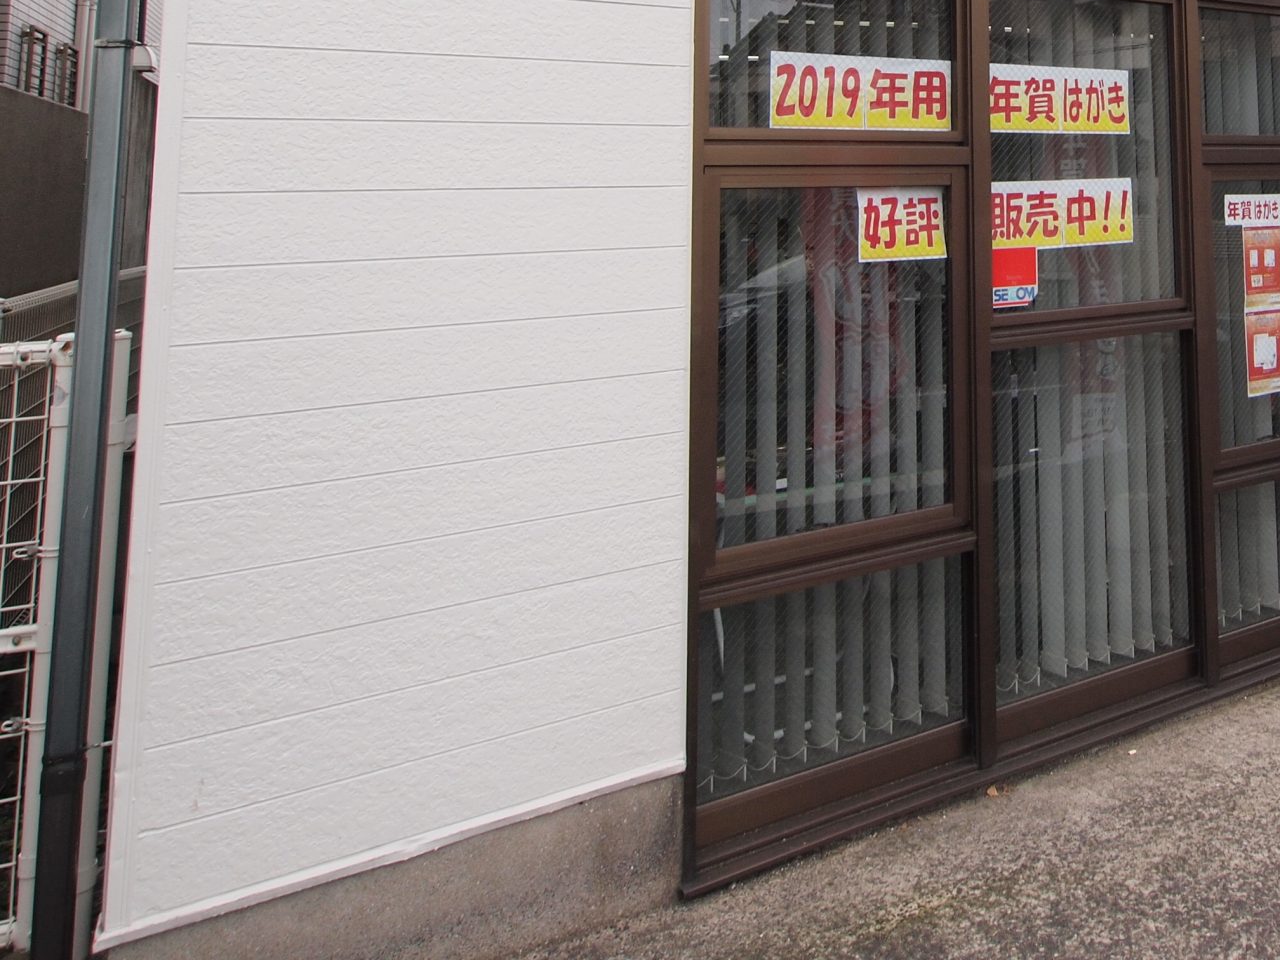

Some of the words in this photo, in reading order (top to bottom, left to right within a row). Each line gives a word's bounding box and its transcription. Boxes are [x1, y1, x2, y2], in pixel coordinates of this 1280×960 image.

[774, 63, 949, 122] 2019年用
[989, 75, 1126, 125] 年賀はがき
[863, 196, 941, 250] 好評
[991, 189, 1129, 239] 販売中!!
[1227, 200, 1279, 221] 年賀はがき
[993, 287, 1035, 302] SECOM
